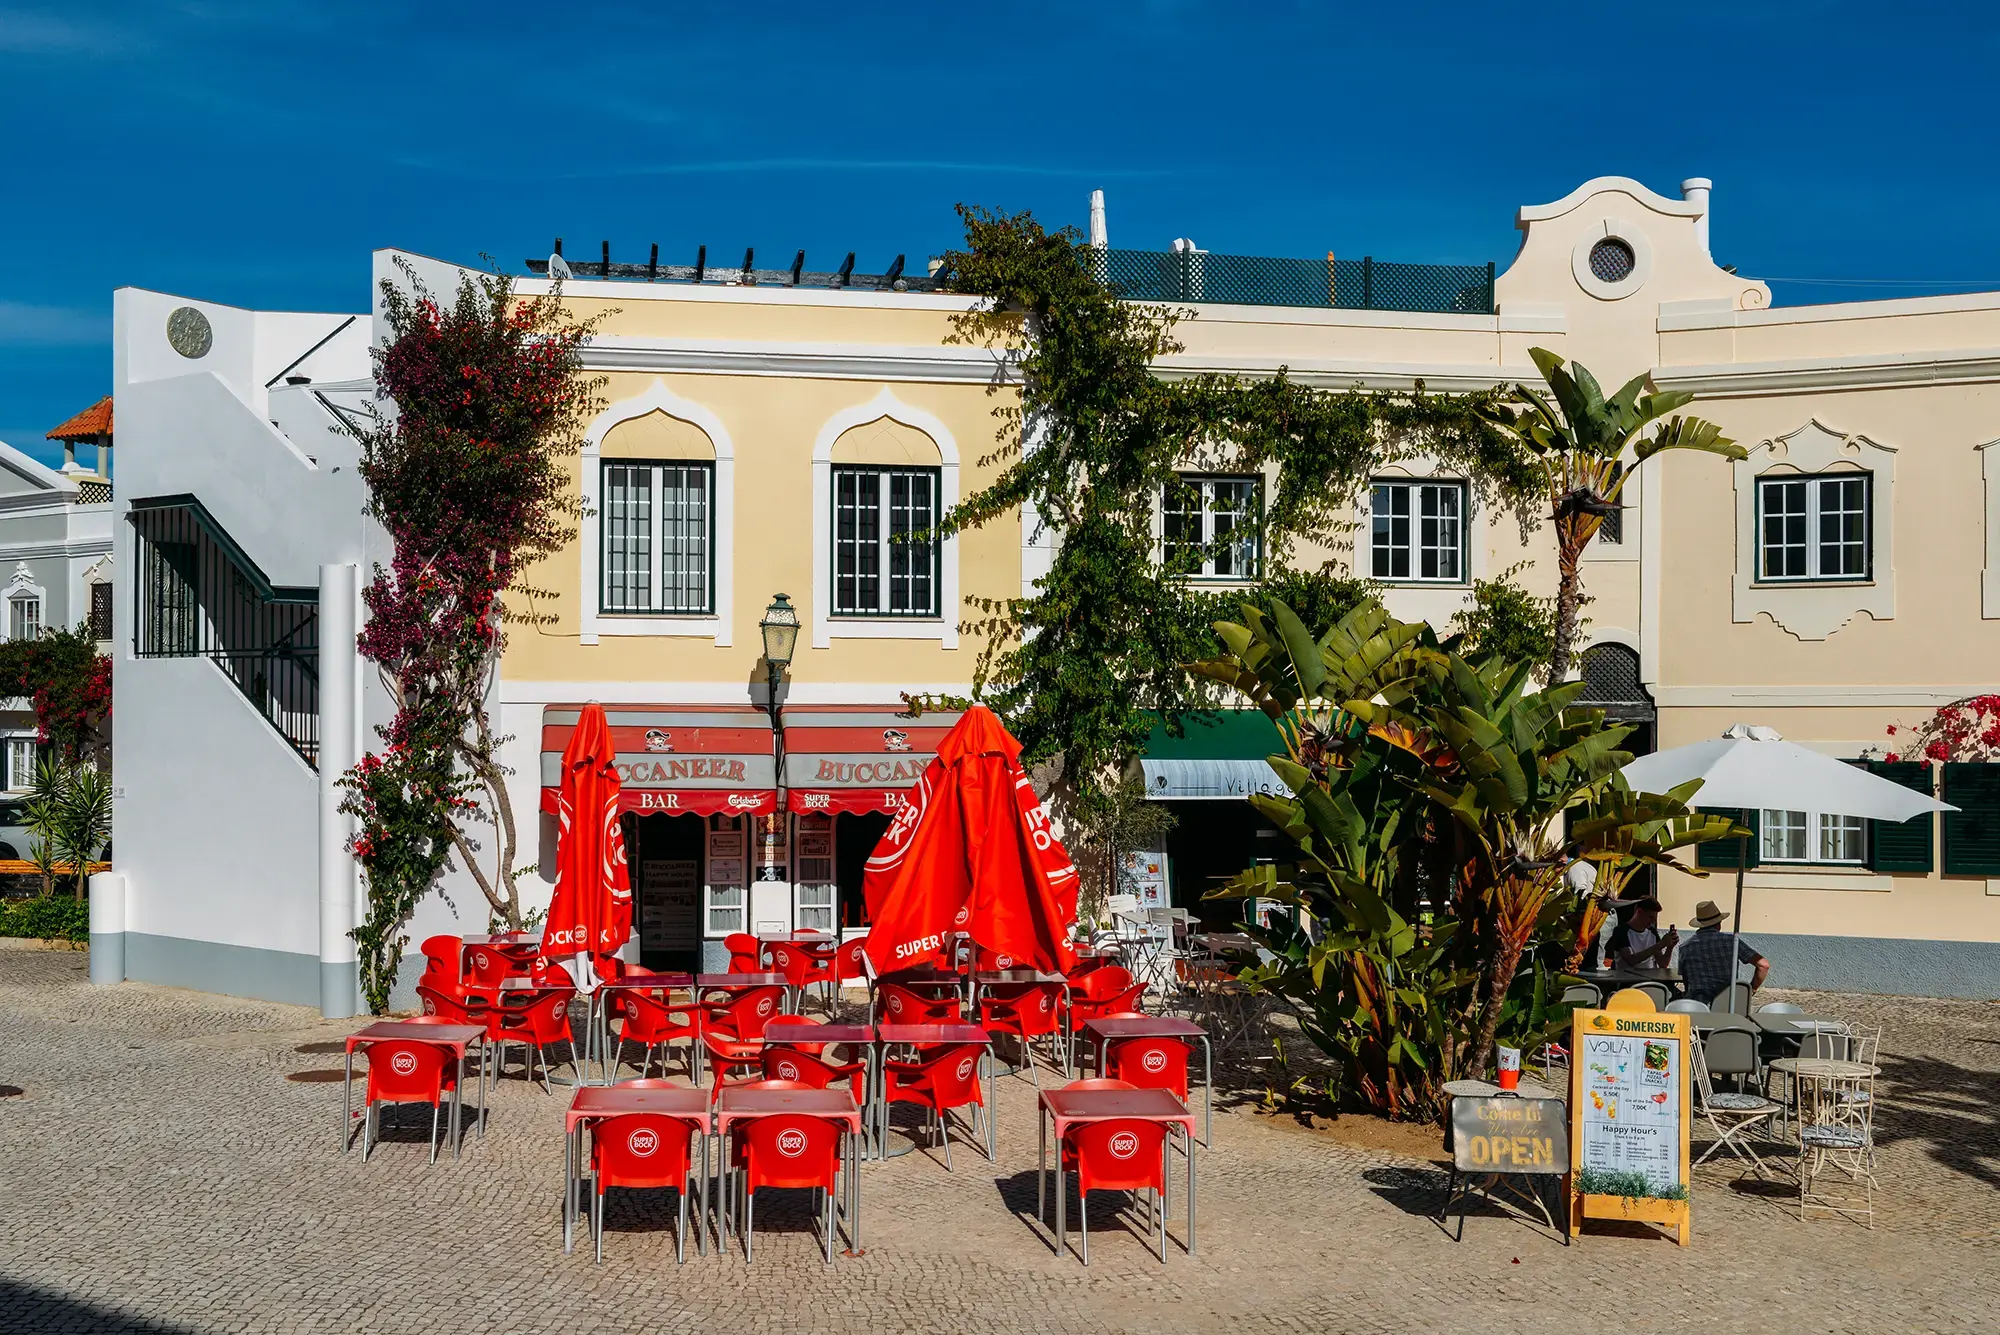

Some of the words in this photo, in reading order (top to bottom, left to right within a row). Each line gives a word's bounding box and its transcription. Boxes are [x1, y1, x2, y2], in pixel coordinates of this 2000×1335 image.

[553, 266, 567, 278] ZON
[815, 758, 937, 782] BUCCAN
[640, 793, 680, 808] BAR
[728, 794, 764, 809] Carlsberg
[804, 794, 830, 802] SUPER
[805, 800, 830, 808] BOCK
[884, 792, 906, 807] BA
[896, 935, 941, 959] SUPER
[1616, 1019, 1675, 1034] SOMERSBY
[1477, 1105, 1521, 1121] Come
[1602, 1125, 1628, 1134] Happy
[1471, 1135, 1553, 1165] OPEN
